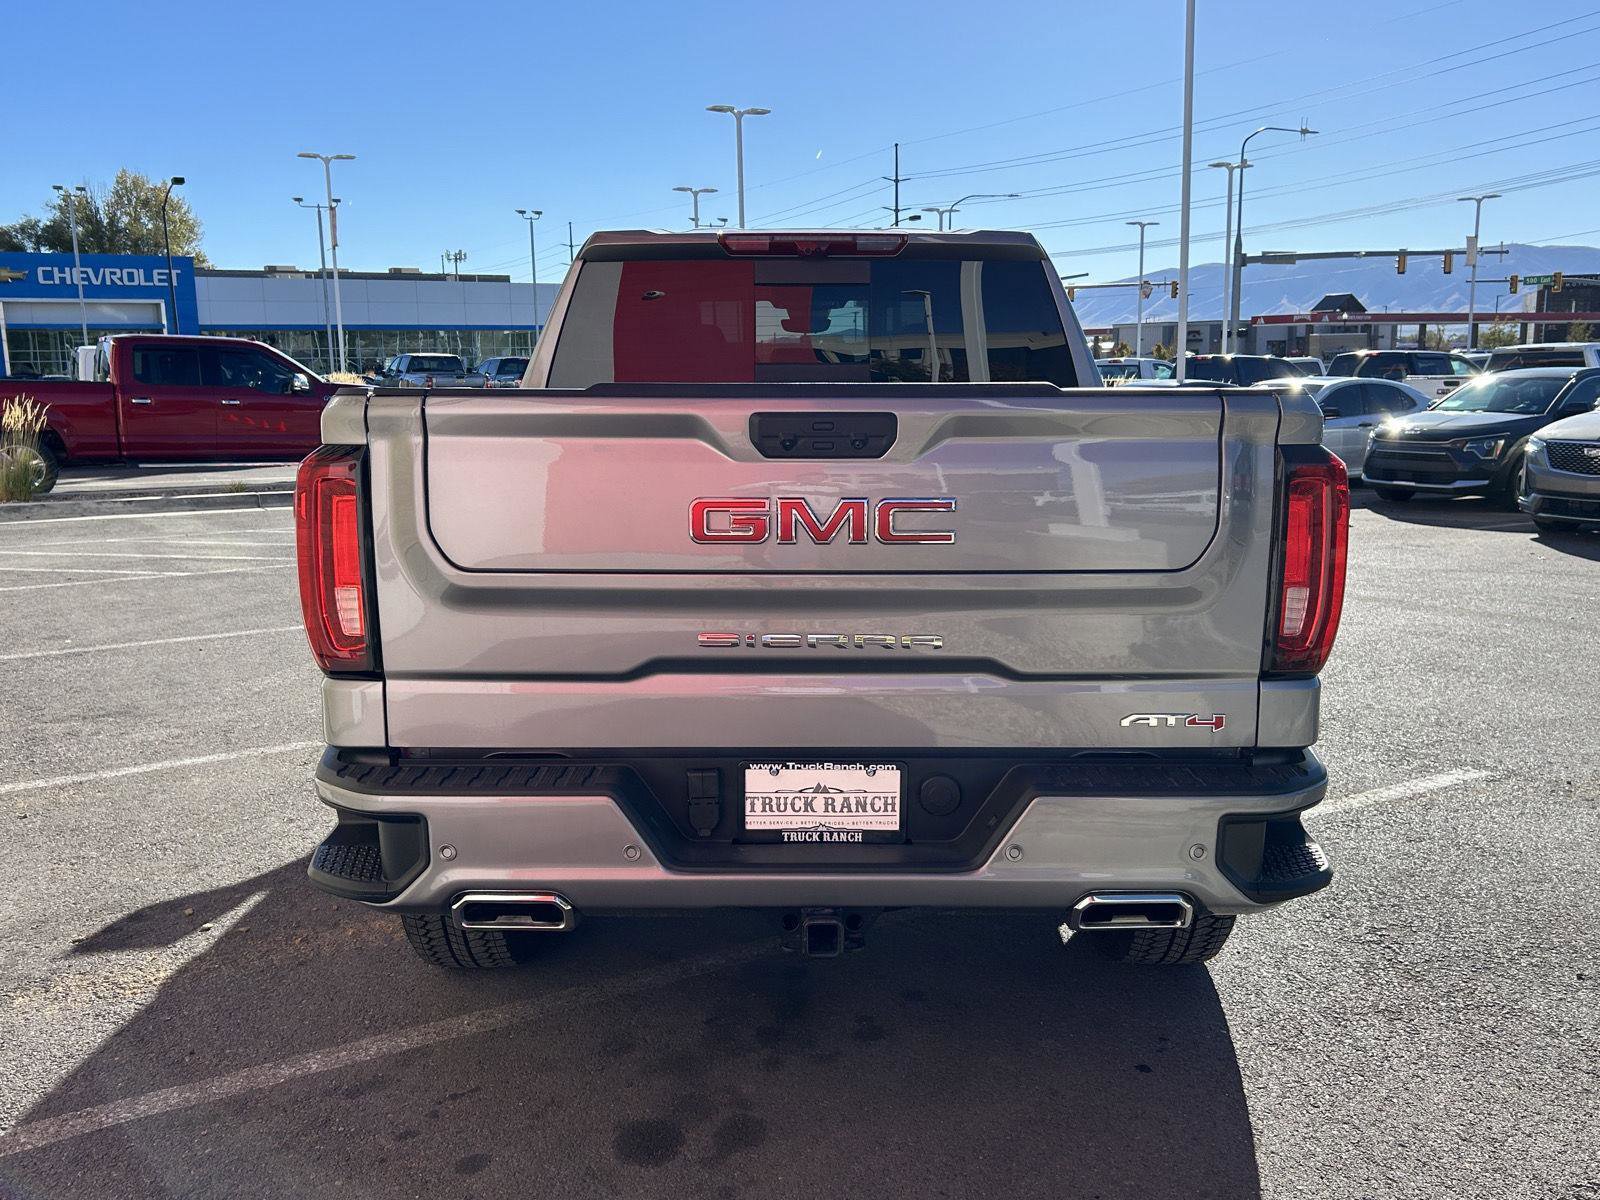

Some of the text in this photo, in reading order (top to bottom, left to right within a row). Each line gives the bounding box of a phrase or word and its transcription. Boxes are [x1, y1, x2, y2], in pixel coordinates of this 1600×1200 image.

[37, 266, 181, 286] CHEVROLET
[688, 496, 957, 545] GMC
[697, 632, 943, 649] SIERRA
[1120, 713, 1226, 732] AT4
[749, 762, 897, 771] www.TruckRanch.com
[745, 796, 897, 813] TRUCK RANCH
[782, 832, 863, 842] TRUCK RANCH
